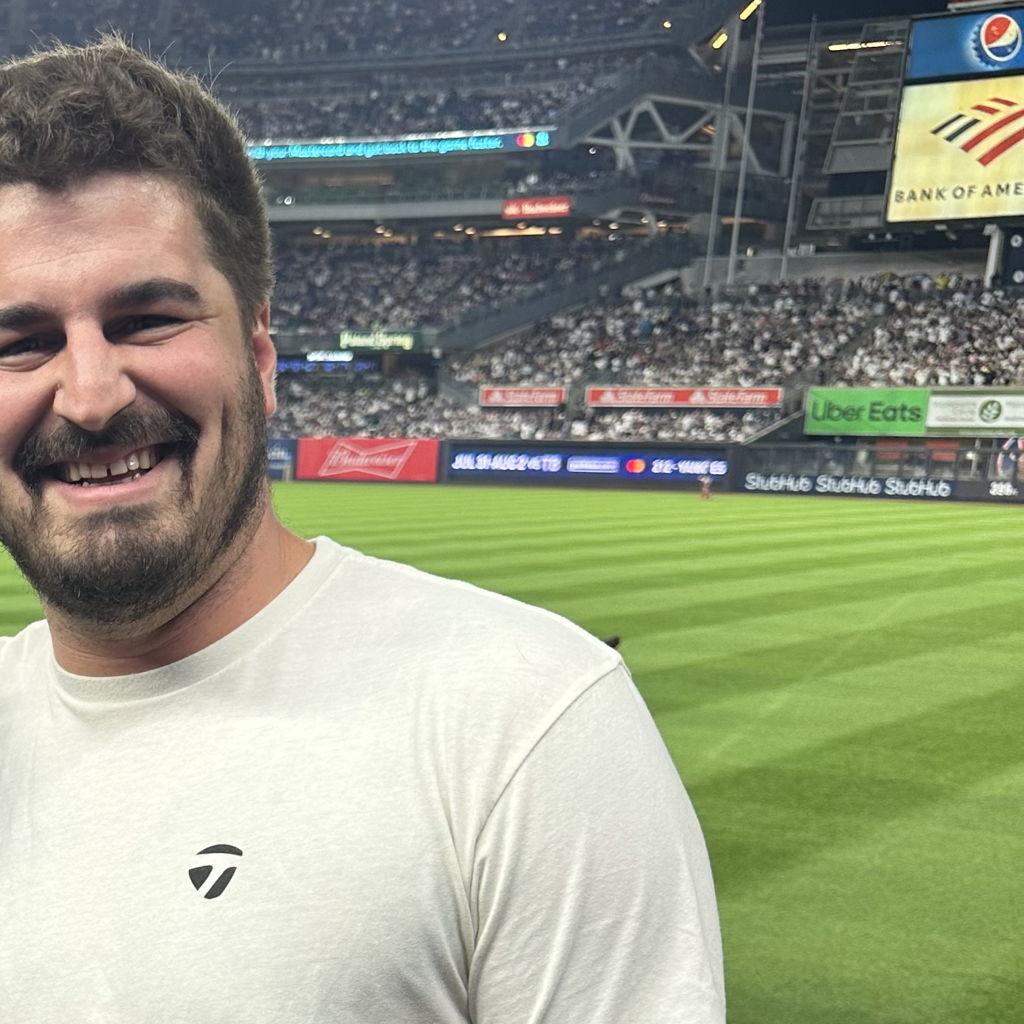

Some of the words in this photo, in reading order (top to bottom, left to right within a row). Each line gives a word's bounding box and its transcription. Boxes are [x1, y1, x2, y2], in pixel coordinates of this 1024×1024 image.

[895, 187, 947, 203] BANK
[952, 185, 976, 200] OF
[811, 401, 865, 422] Uber
[869, 401, 921, 422] Eats
[745, 472, 813, 492] StubHub
[815, 474, 882, 494] StubHub
[884, 476, 952, 497] StubHub
